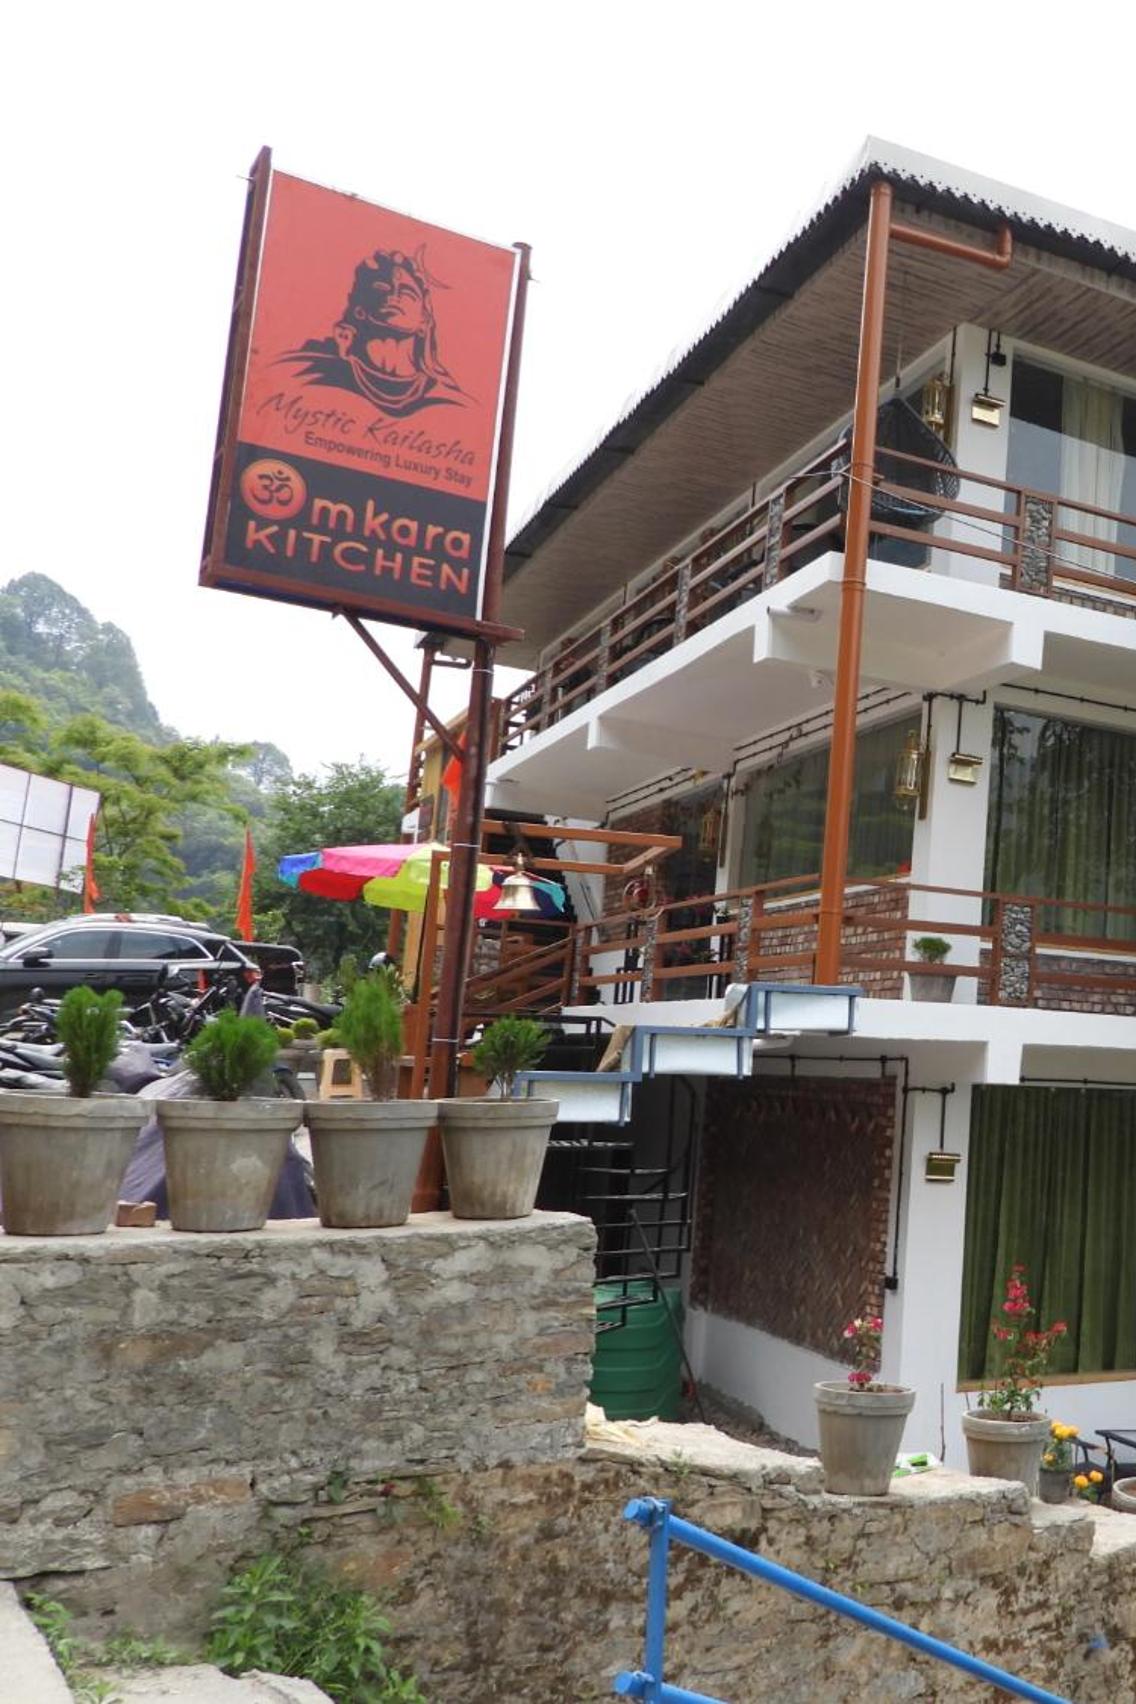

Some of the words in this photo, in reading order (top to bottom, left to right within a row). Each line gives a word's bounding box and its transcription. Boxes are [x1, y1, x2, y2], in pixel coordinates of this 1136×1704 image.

[256, 392, 355, 434] Mystic
[363, 417, 476, 466] Kailasha
[304, 431, 391, 469] Empowering
[395, 454, 441, 480] Luxury
[445, 465, 473, 488] Stay
[245, 520, 469, 595] KITCHEN
